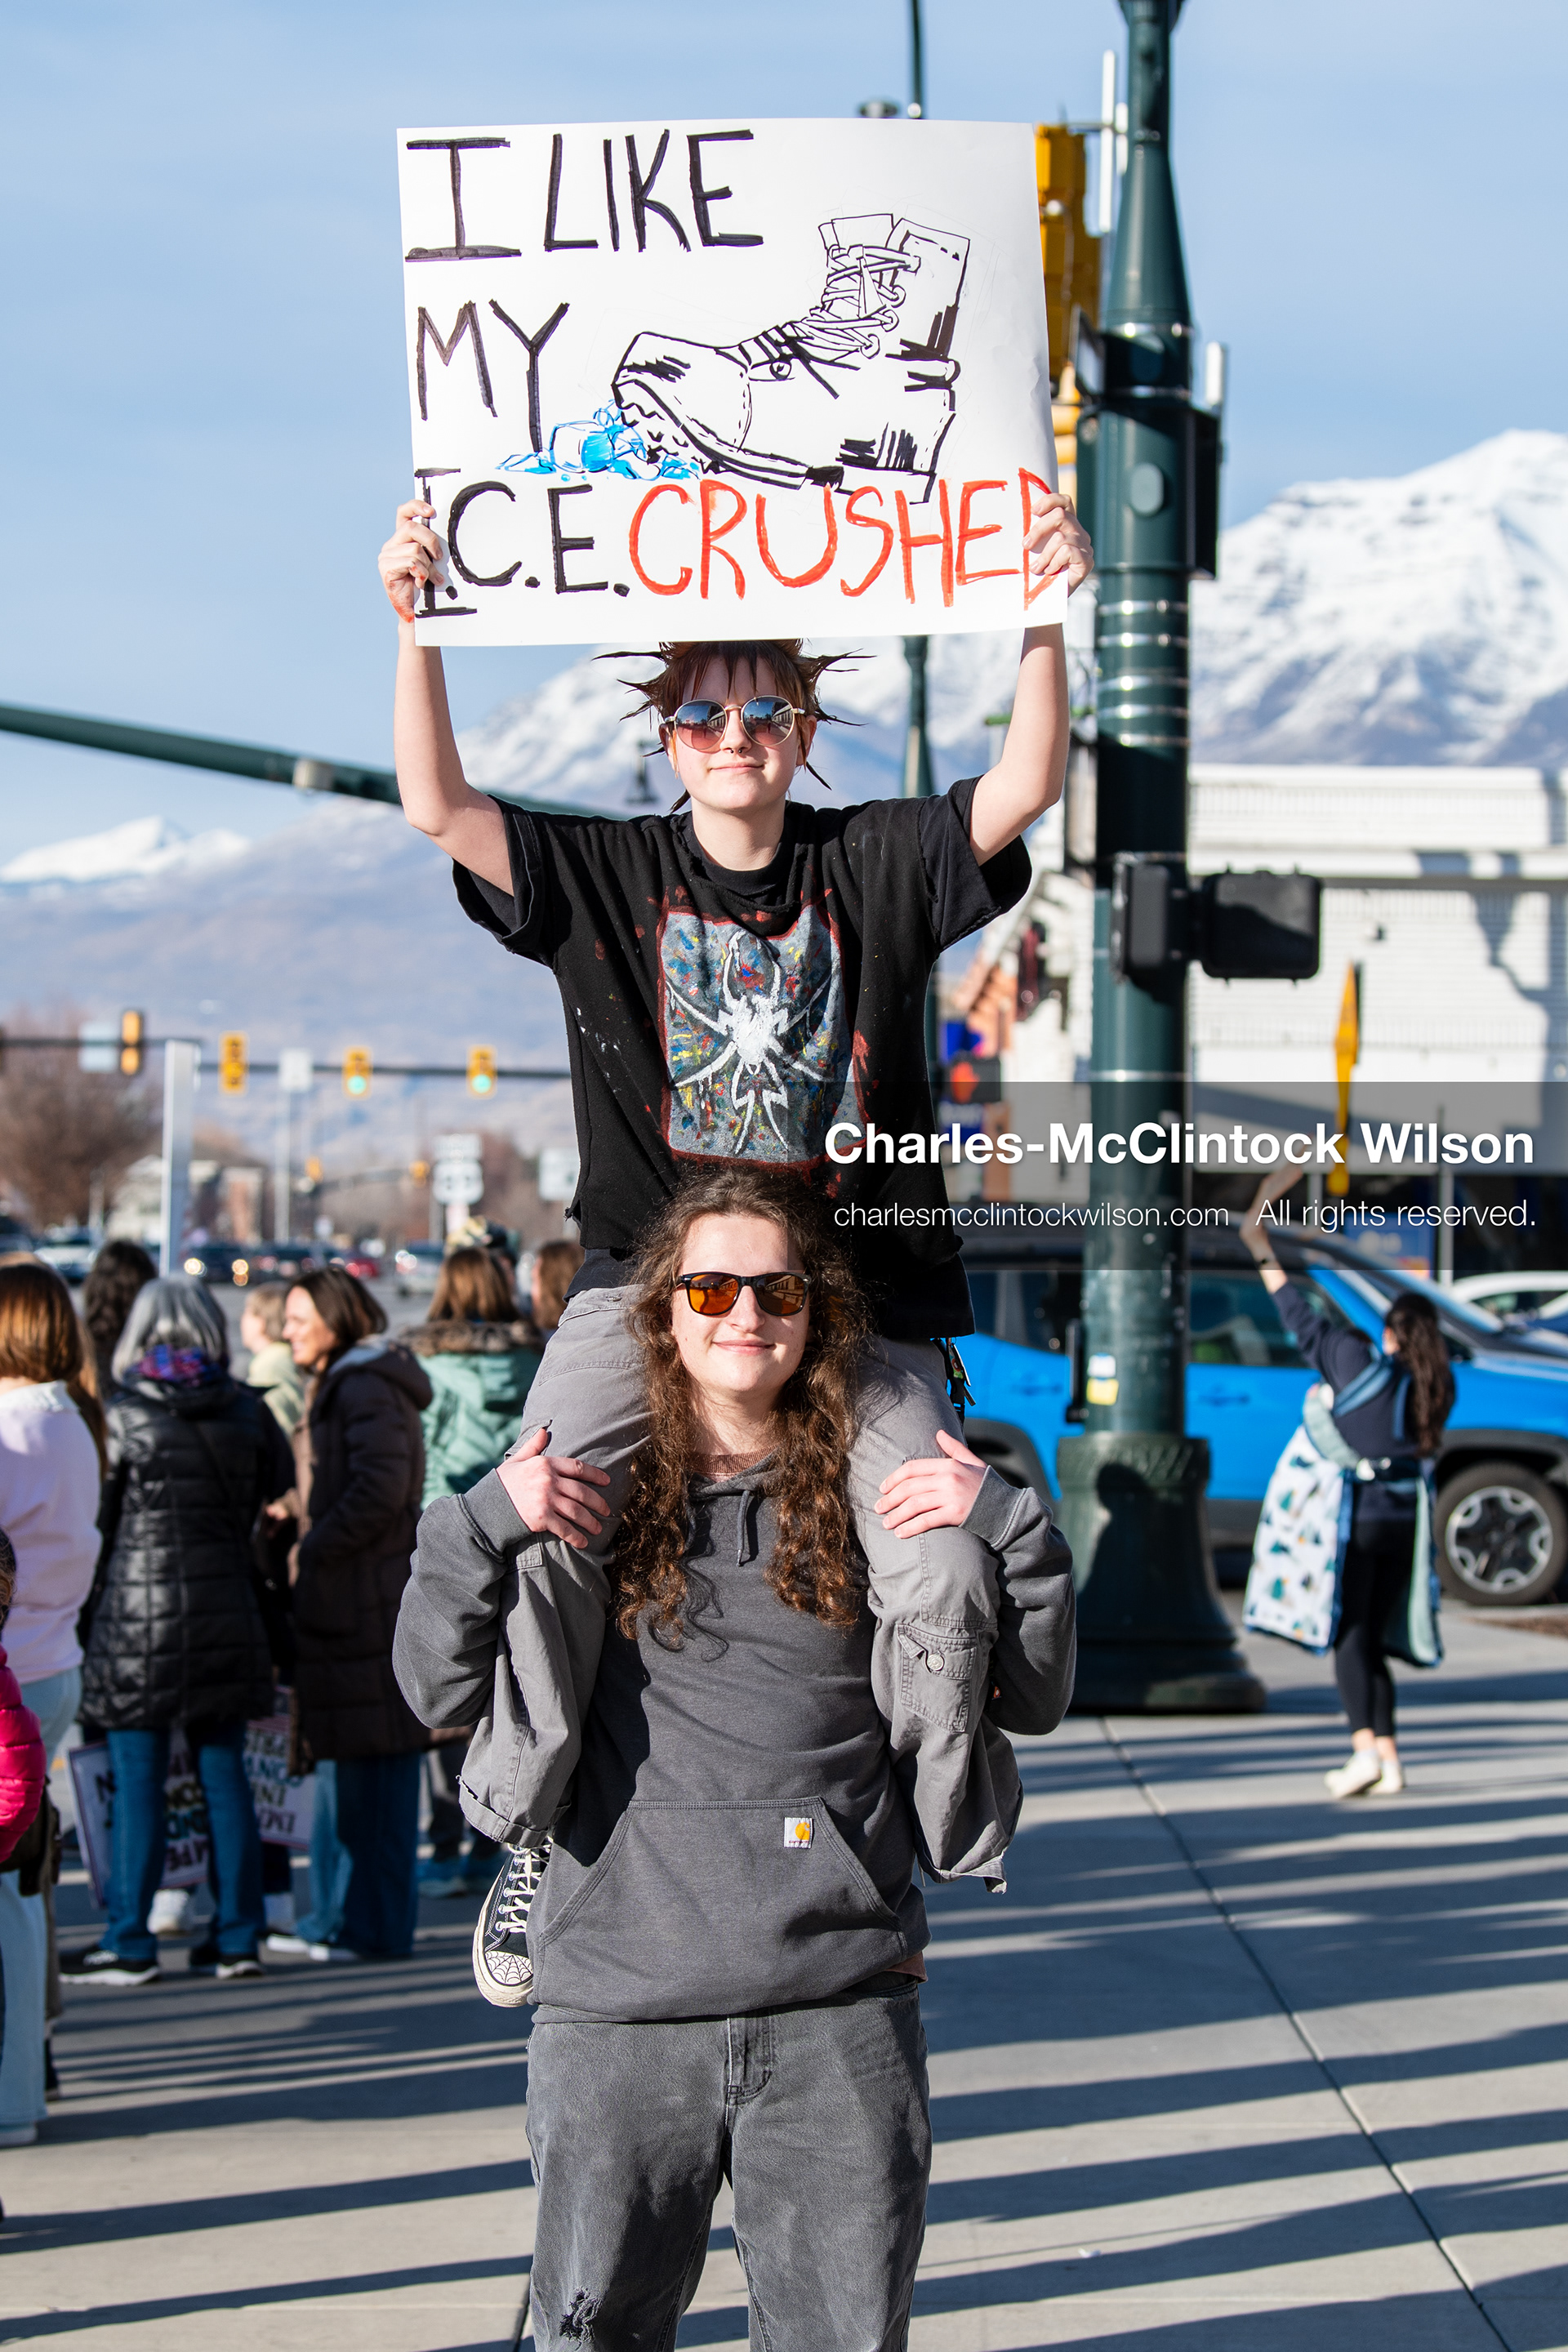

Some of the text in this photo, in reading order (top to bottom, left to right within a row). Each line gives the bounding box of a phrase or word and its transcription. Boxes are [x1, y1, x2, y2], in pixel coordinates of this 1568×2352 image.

[405, 129, 764, 262] I LIKE
[416, 300, 570, 452] MY
